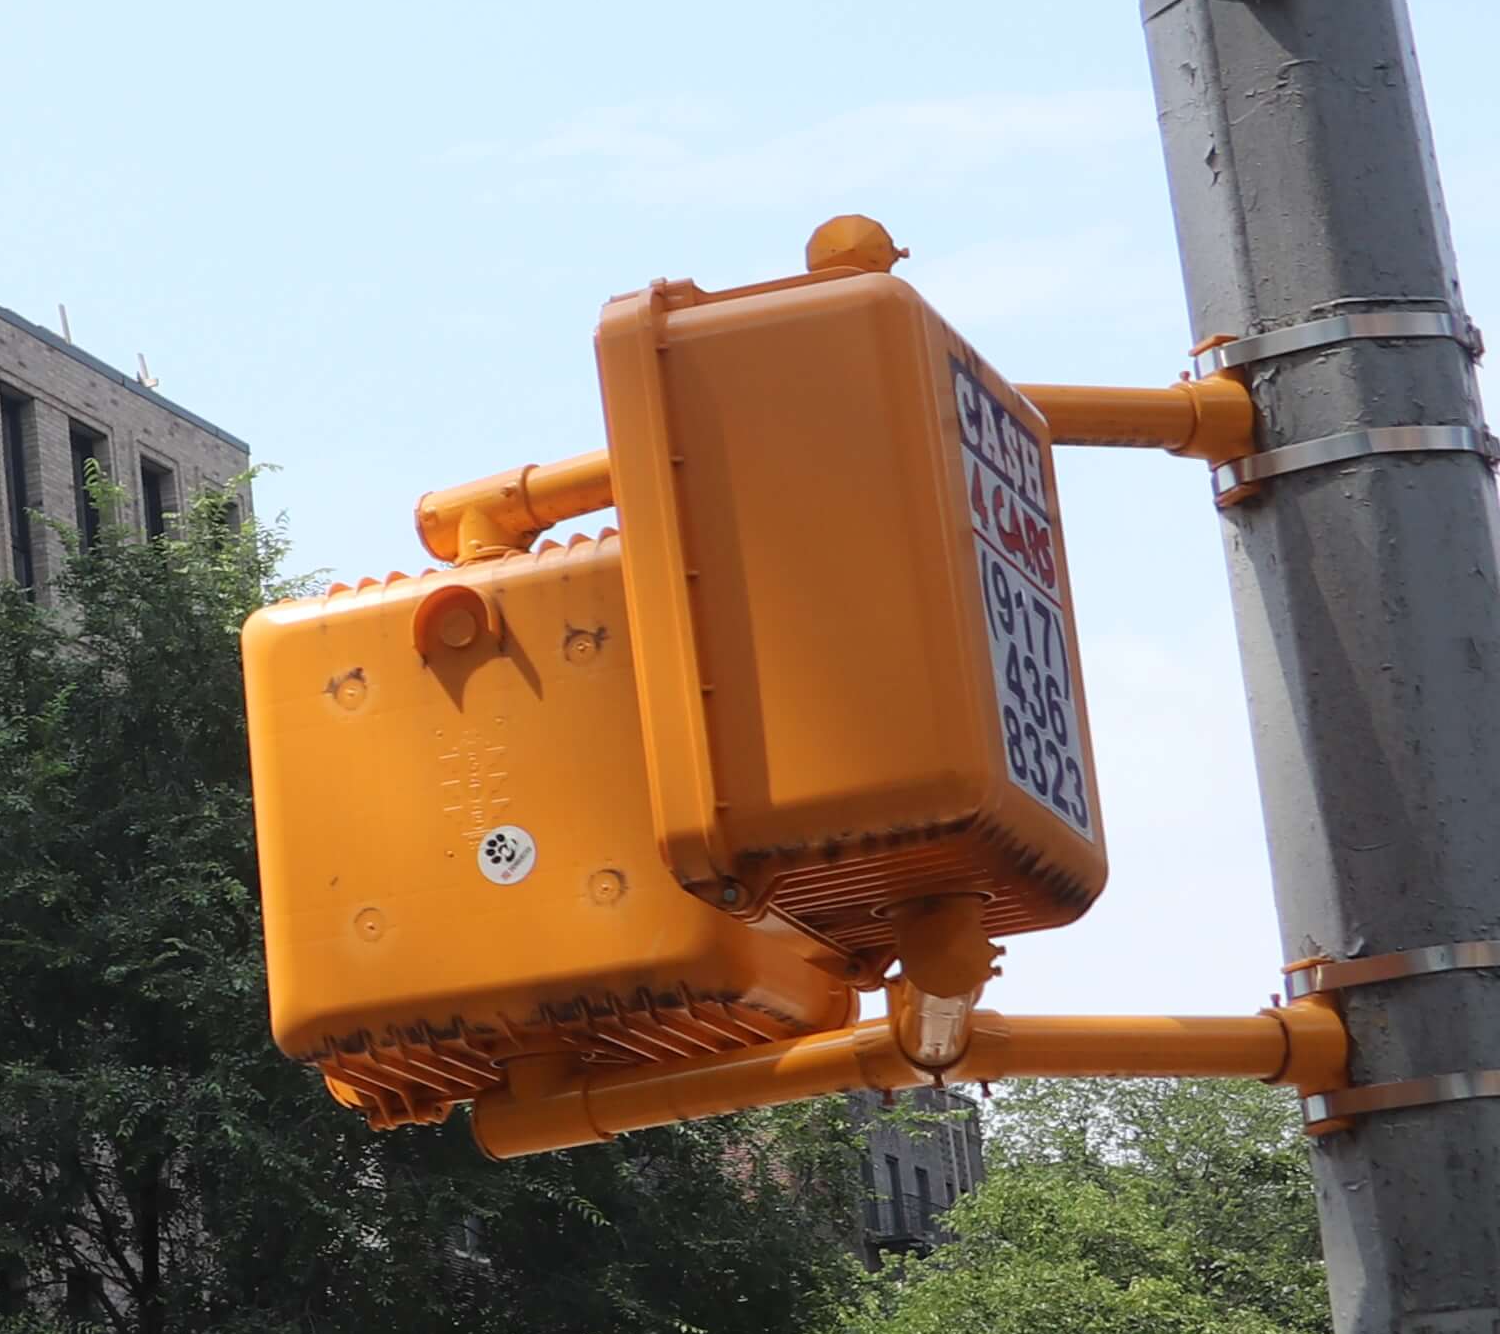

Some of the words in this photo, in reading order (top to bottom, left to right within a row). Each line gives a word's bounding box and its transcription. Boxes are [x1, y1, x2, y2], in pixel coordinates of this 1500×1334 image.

[970, 460, 988, 532] 4
[991, 484, 1057, 591] CARS
[981, 549, 1071, 702] (917)
[1004, 652, 1068, 748] 436
[1001, 704, 1090, 831] 8323
